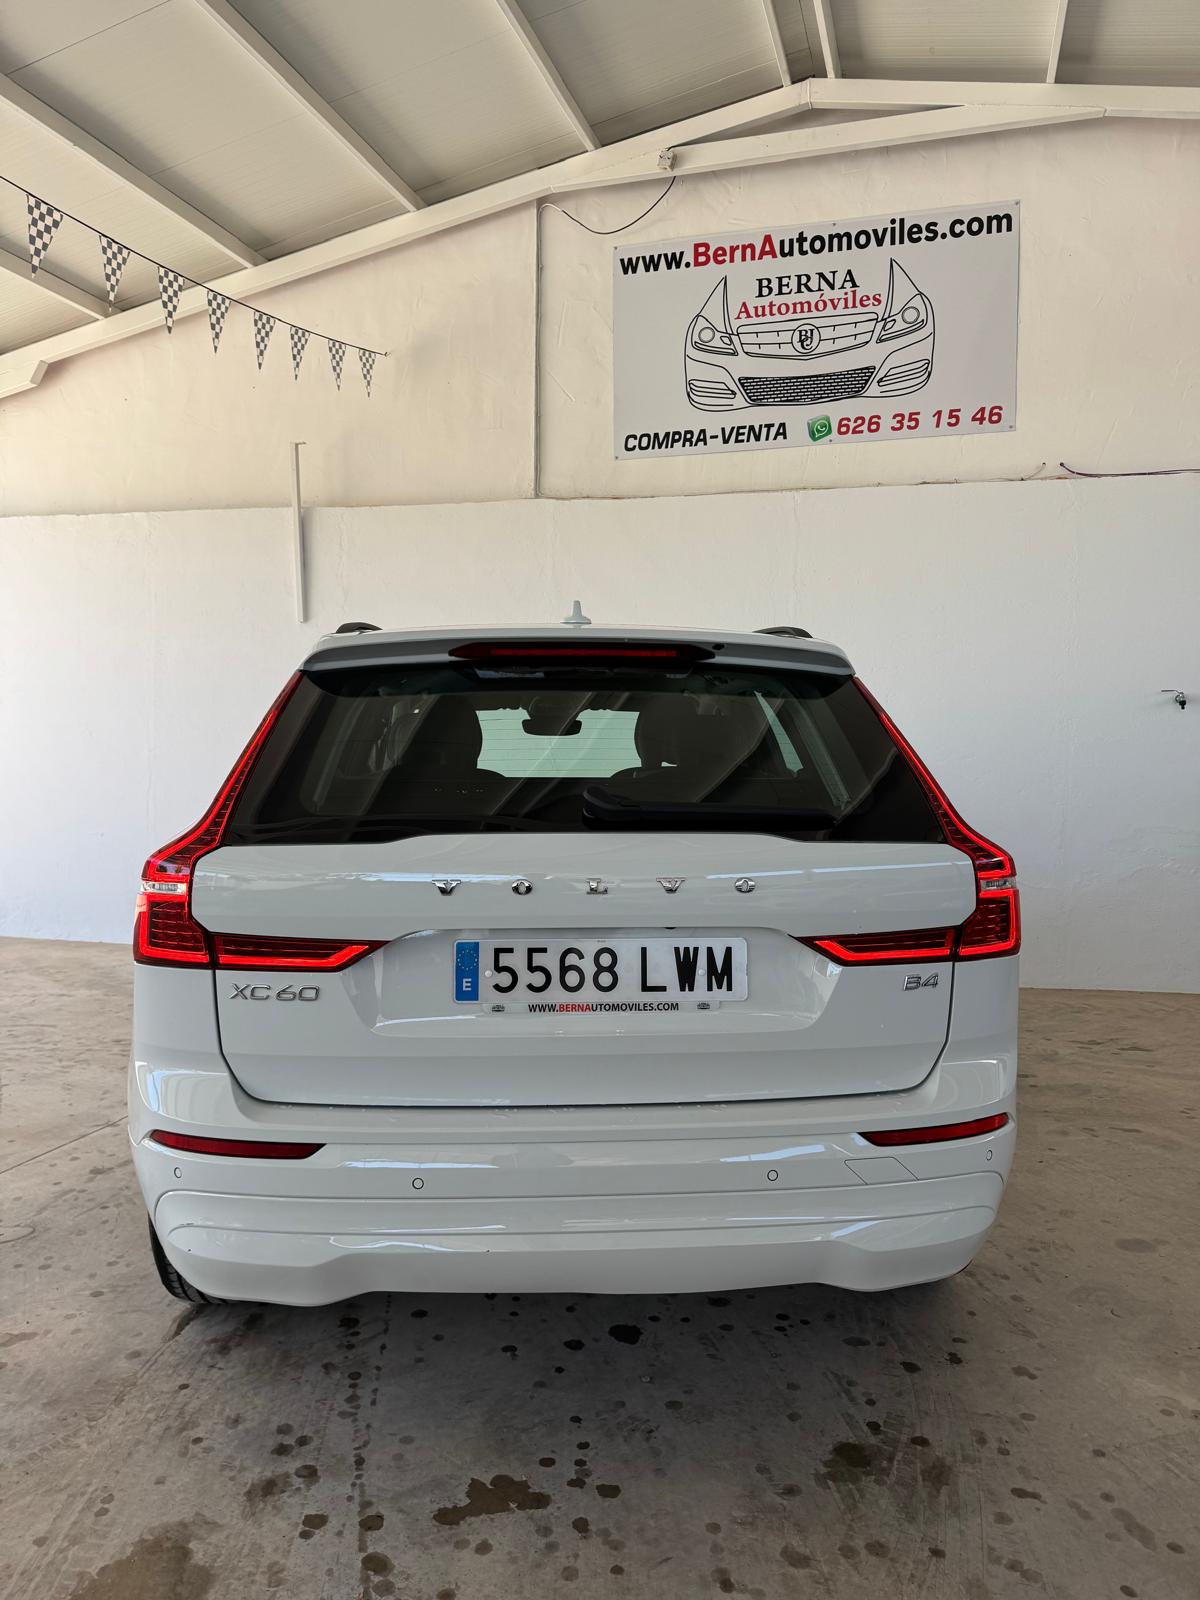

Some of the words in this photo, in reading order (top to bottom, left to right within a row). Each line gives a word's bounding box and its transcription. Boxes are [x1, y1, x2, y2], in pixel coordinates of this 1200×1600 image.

[620, 212, 1012, 275] www.BernAutomoviles.com
[756, 269, 859, 298] BERNA
[735, 290, 882, 320] Automóviles
[837, 414, 881, 436] 626
[890, 411, 920, 432] 35
[932, 408, 961, 429] 15
[971, 405, 1003, 425] 46
[624, 422, 788, 452] COMPRA-VENTA
[432, 877, 756, 896] VOLVO
[492, 947, 619, 993] 5568
[640, 946, 733, 992] LWM
[903, 973, 939, 991] B4
[462, 978, 472, 991] E
[528, 1002, 679, 1014] WWW.BERNAUTOMOVILES.COM
